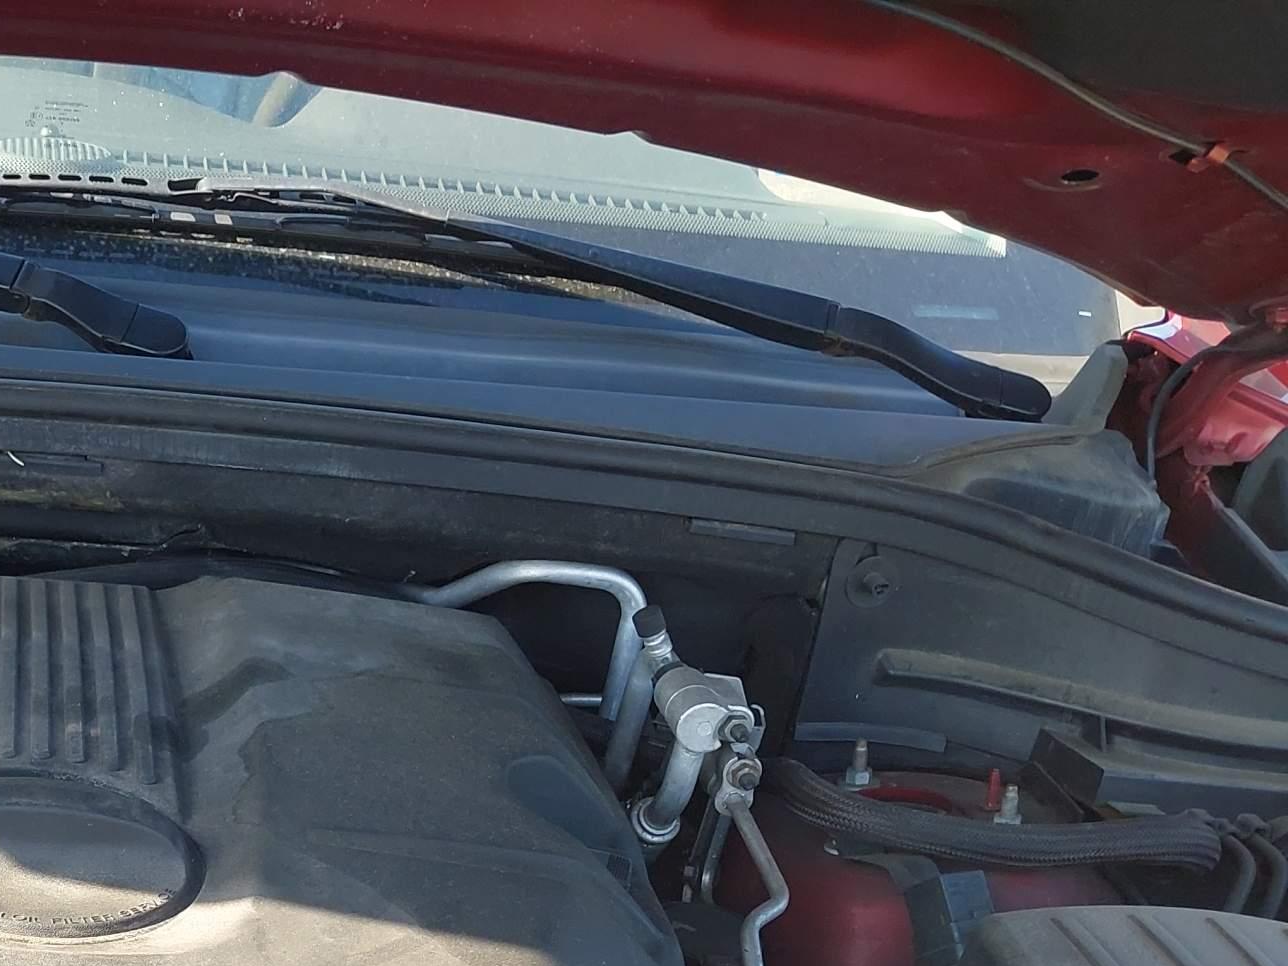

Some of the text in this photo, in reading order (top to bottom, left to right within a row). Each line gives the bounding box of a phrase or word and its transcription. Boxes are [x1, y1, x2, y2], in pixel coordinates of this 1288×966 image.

[12, 914, 40, 923] OIL
[51, 912, 116, 925] FILTER
[119, 888, 178, 918] SERVICE
